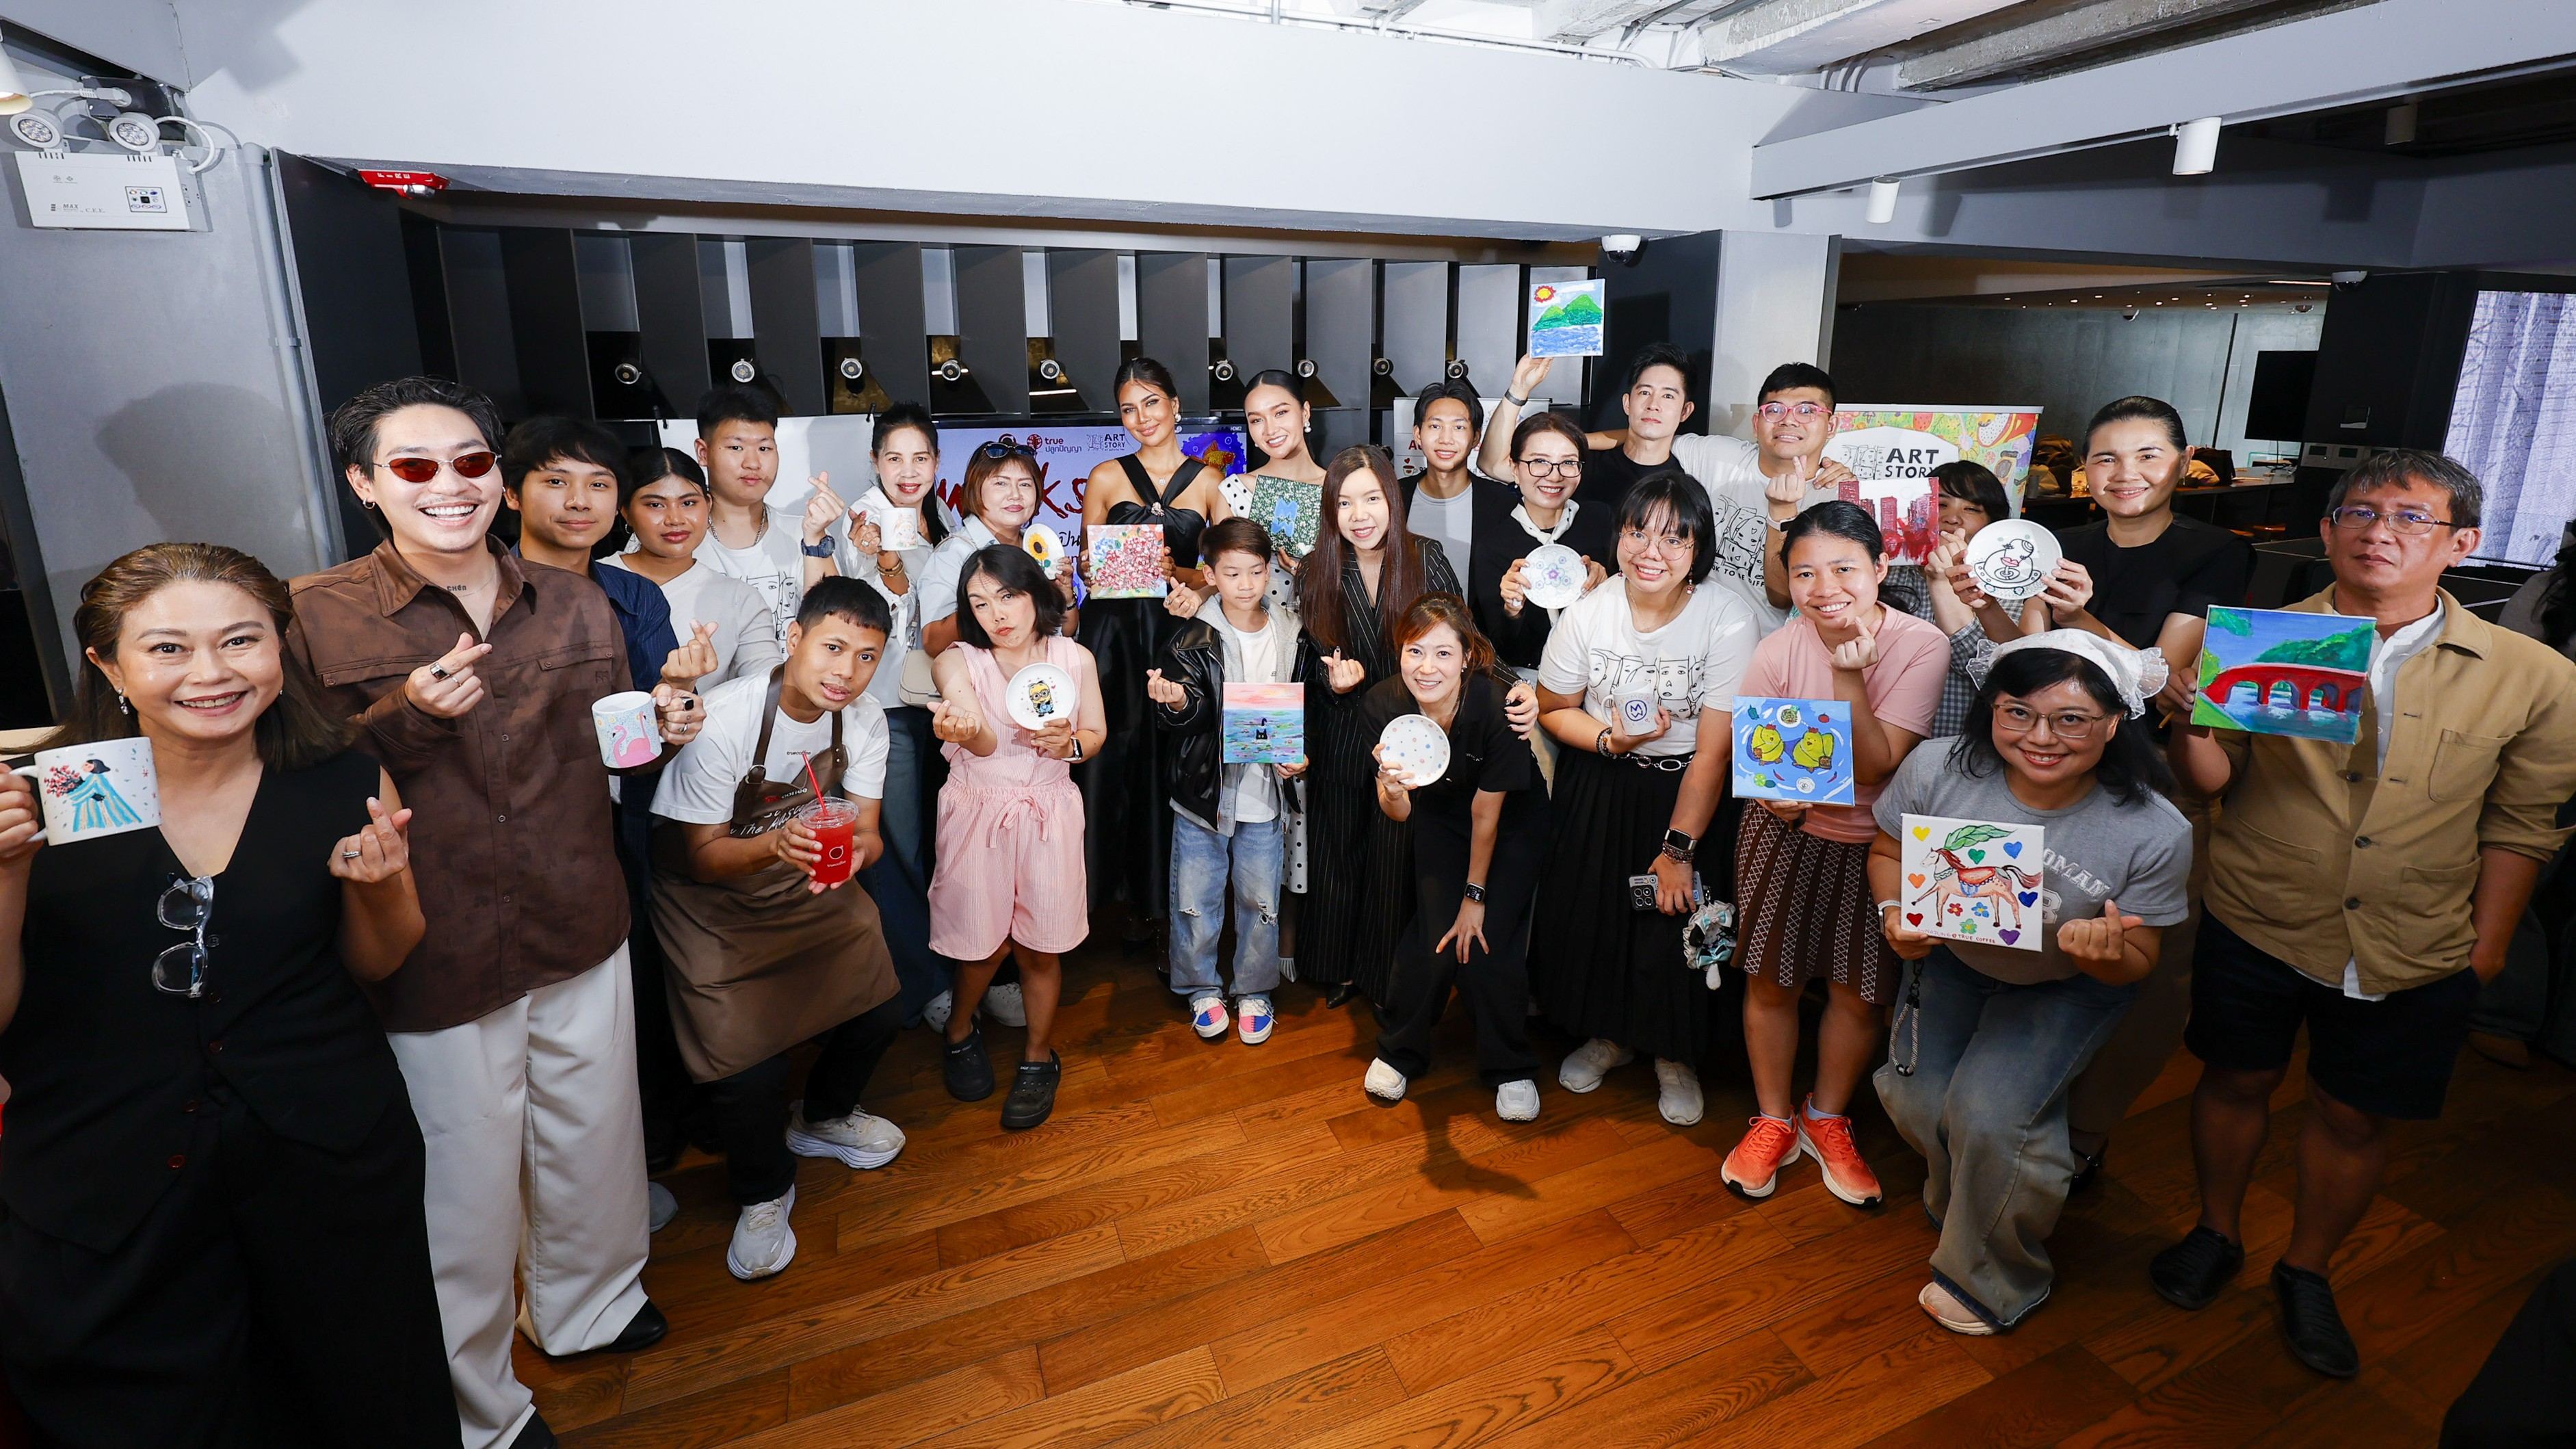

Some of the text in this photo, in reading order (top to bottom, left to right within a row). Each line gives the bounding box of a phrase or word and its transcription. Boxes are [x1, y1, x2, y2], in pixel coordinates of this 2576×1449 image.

[1104, 433, 1125, 441] ART
[1885, 447, 1939, 465] ART
[1724, 569, 1735, 577] TO
